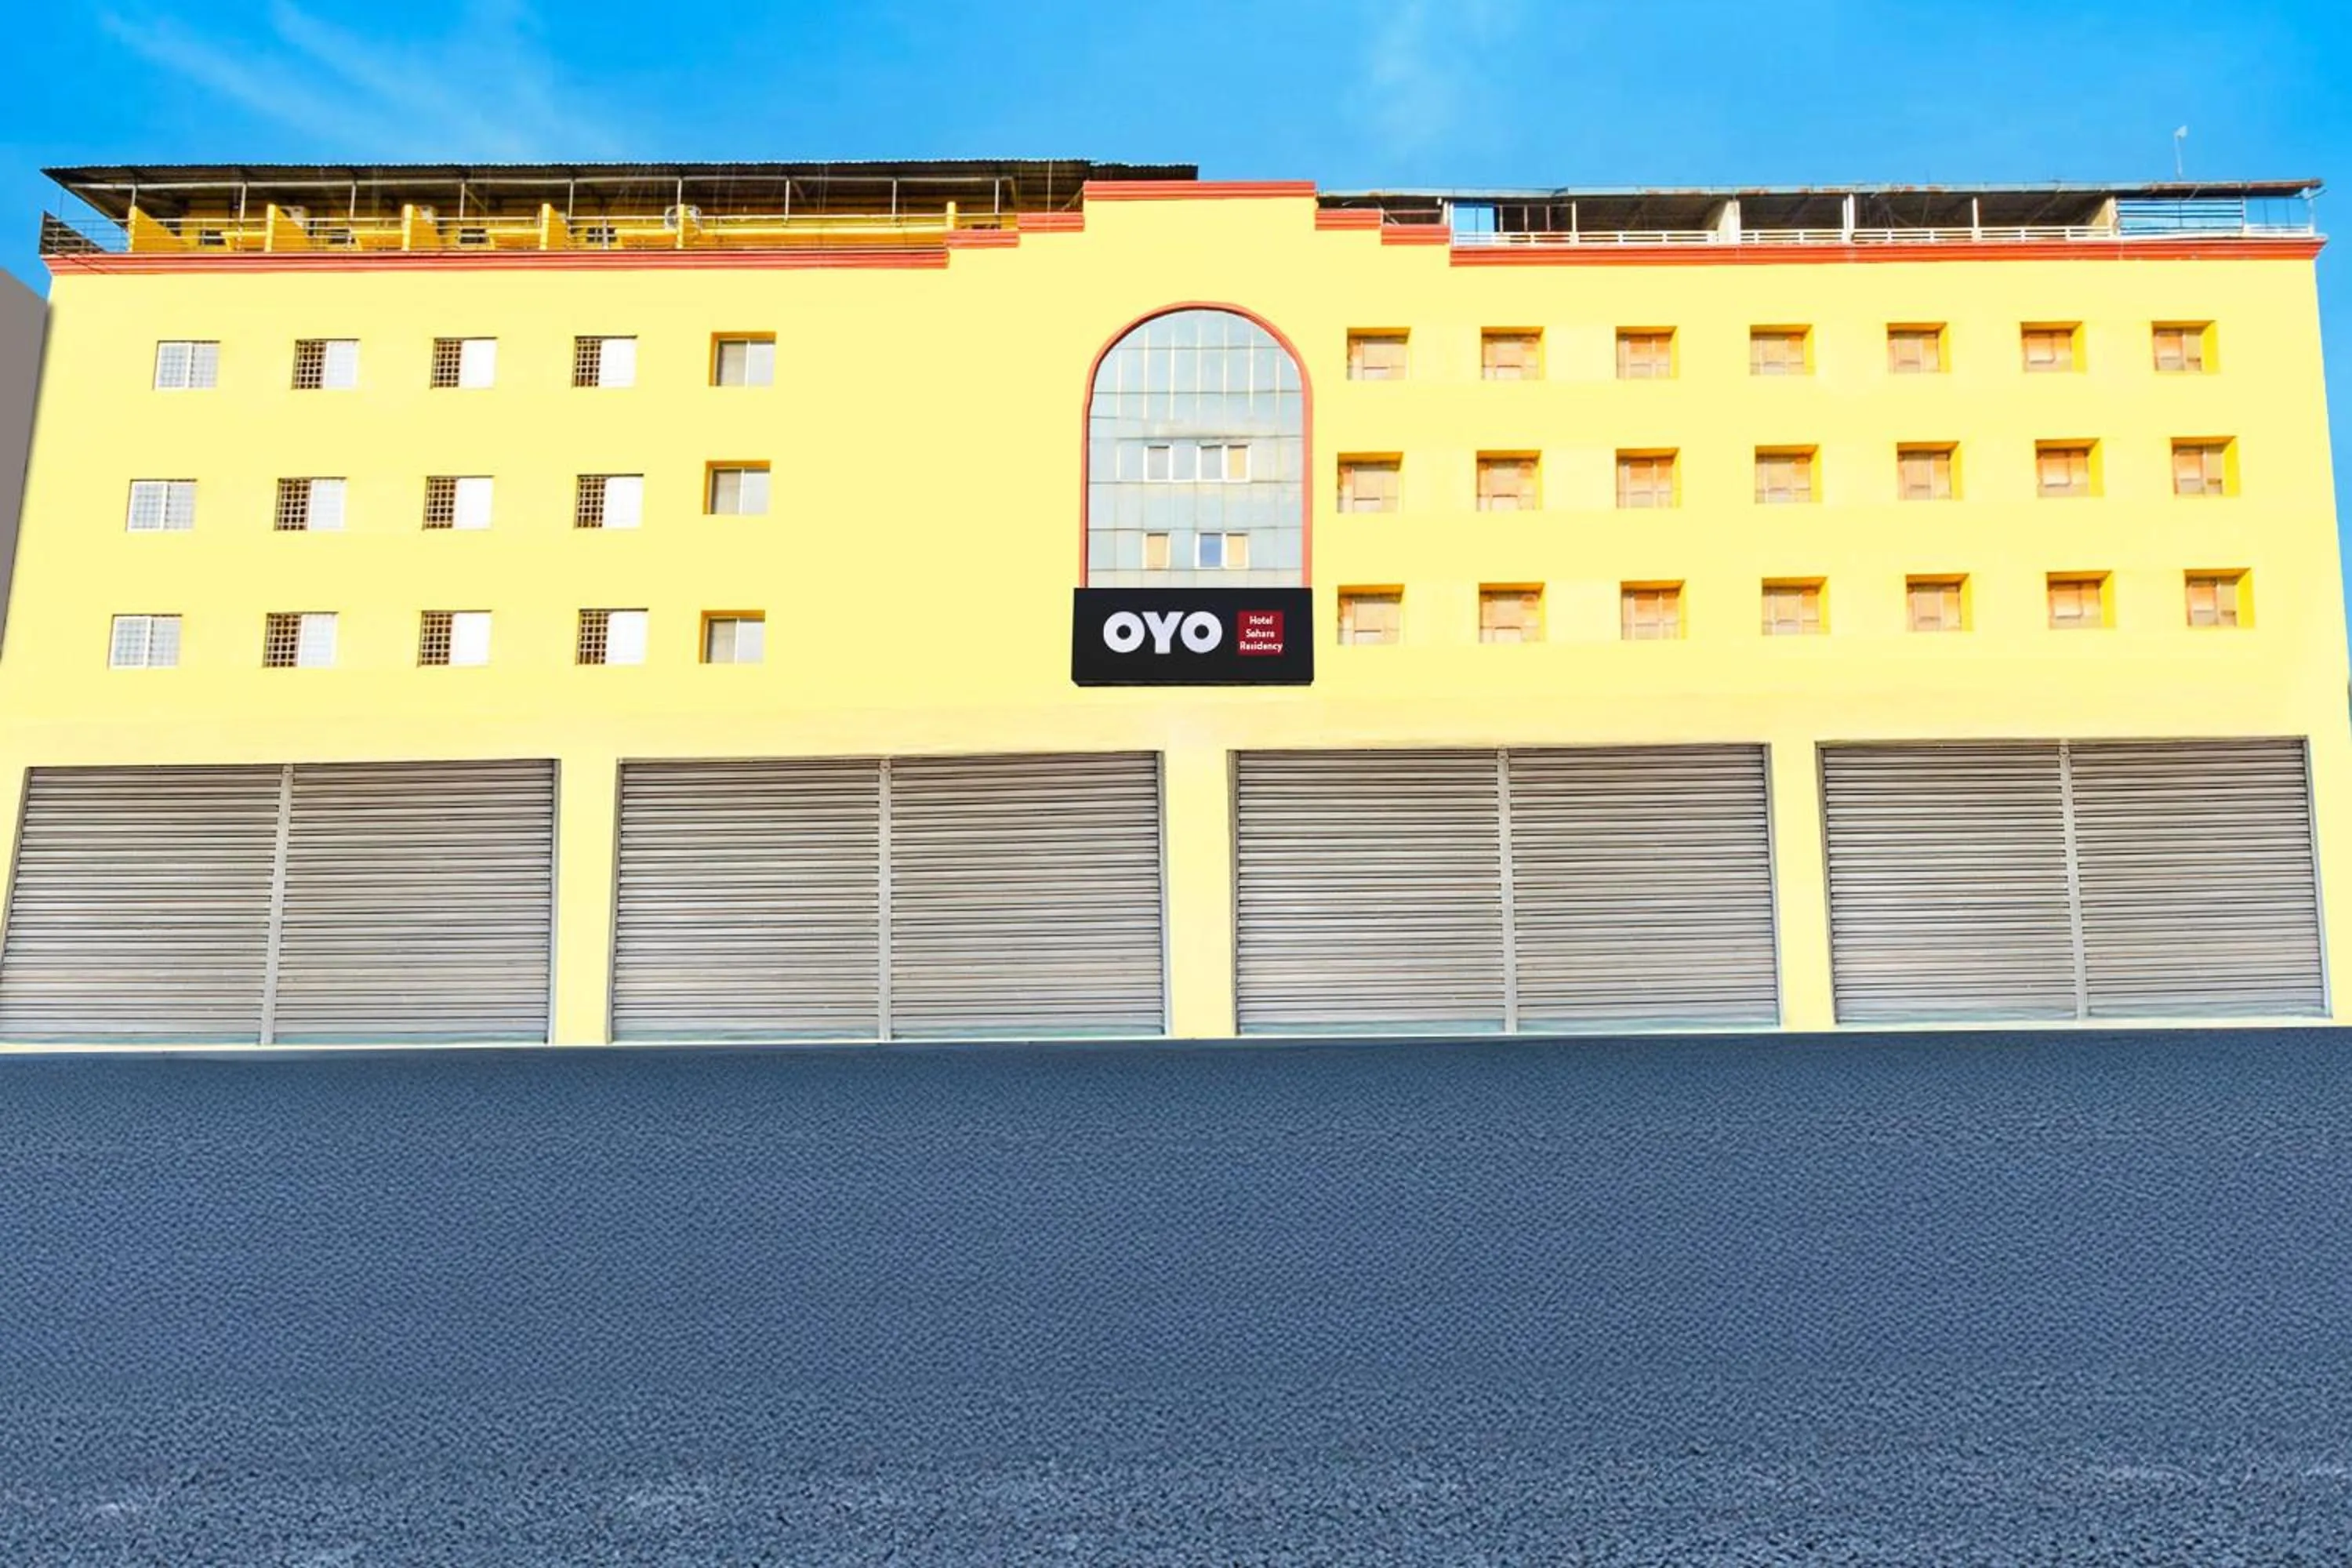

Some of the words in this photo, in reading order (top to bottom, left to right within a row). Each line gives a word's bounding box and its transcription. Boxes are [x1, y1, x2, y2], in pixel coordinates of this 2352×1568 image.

[1249, 615, 1273, 625] Hotel
[1103, 611, 1222, 654] OYO
[1240, 641, 1283, 653] Residency
